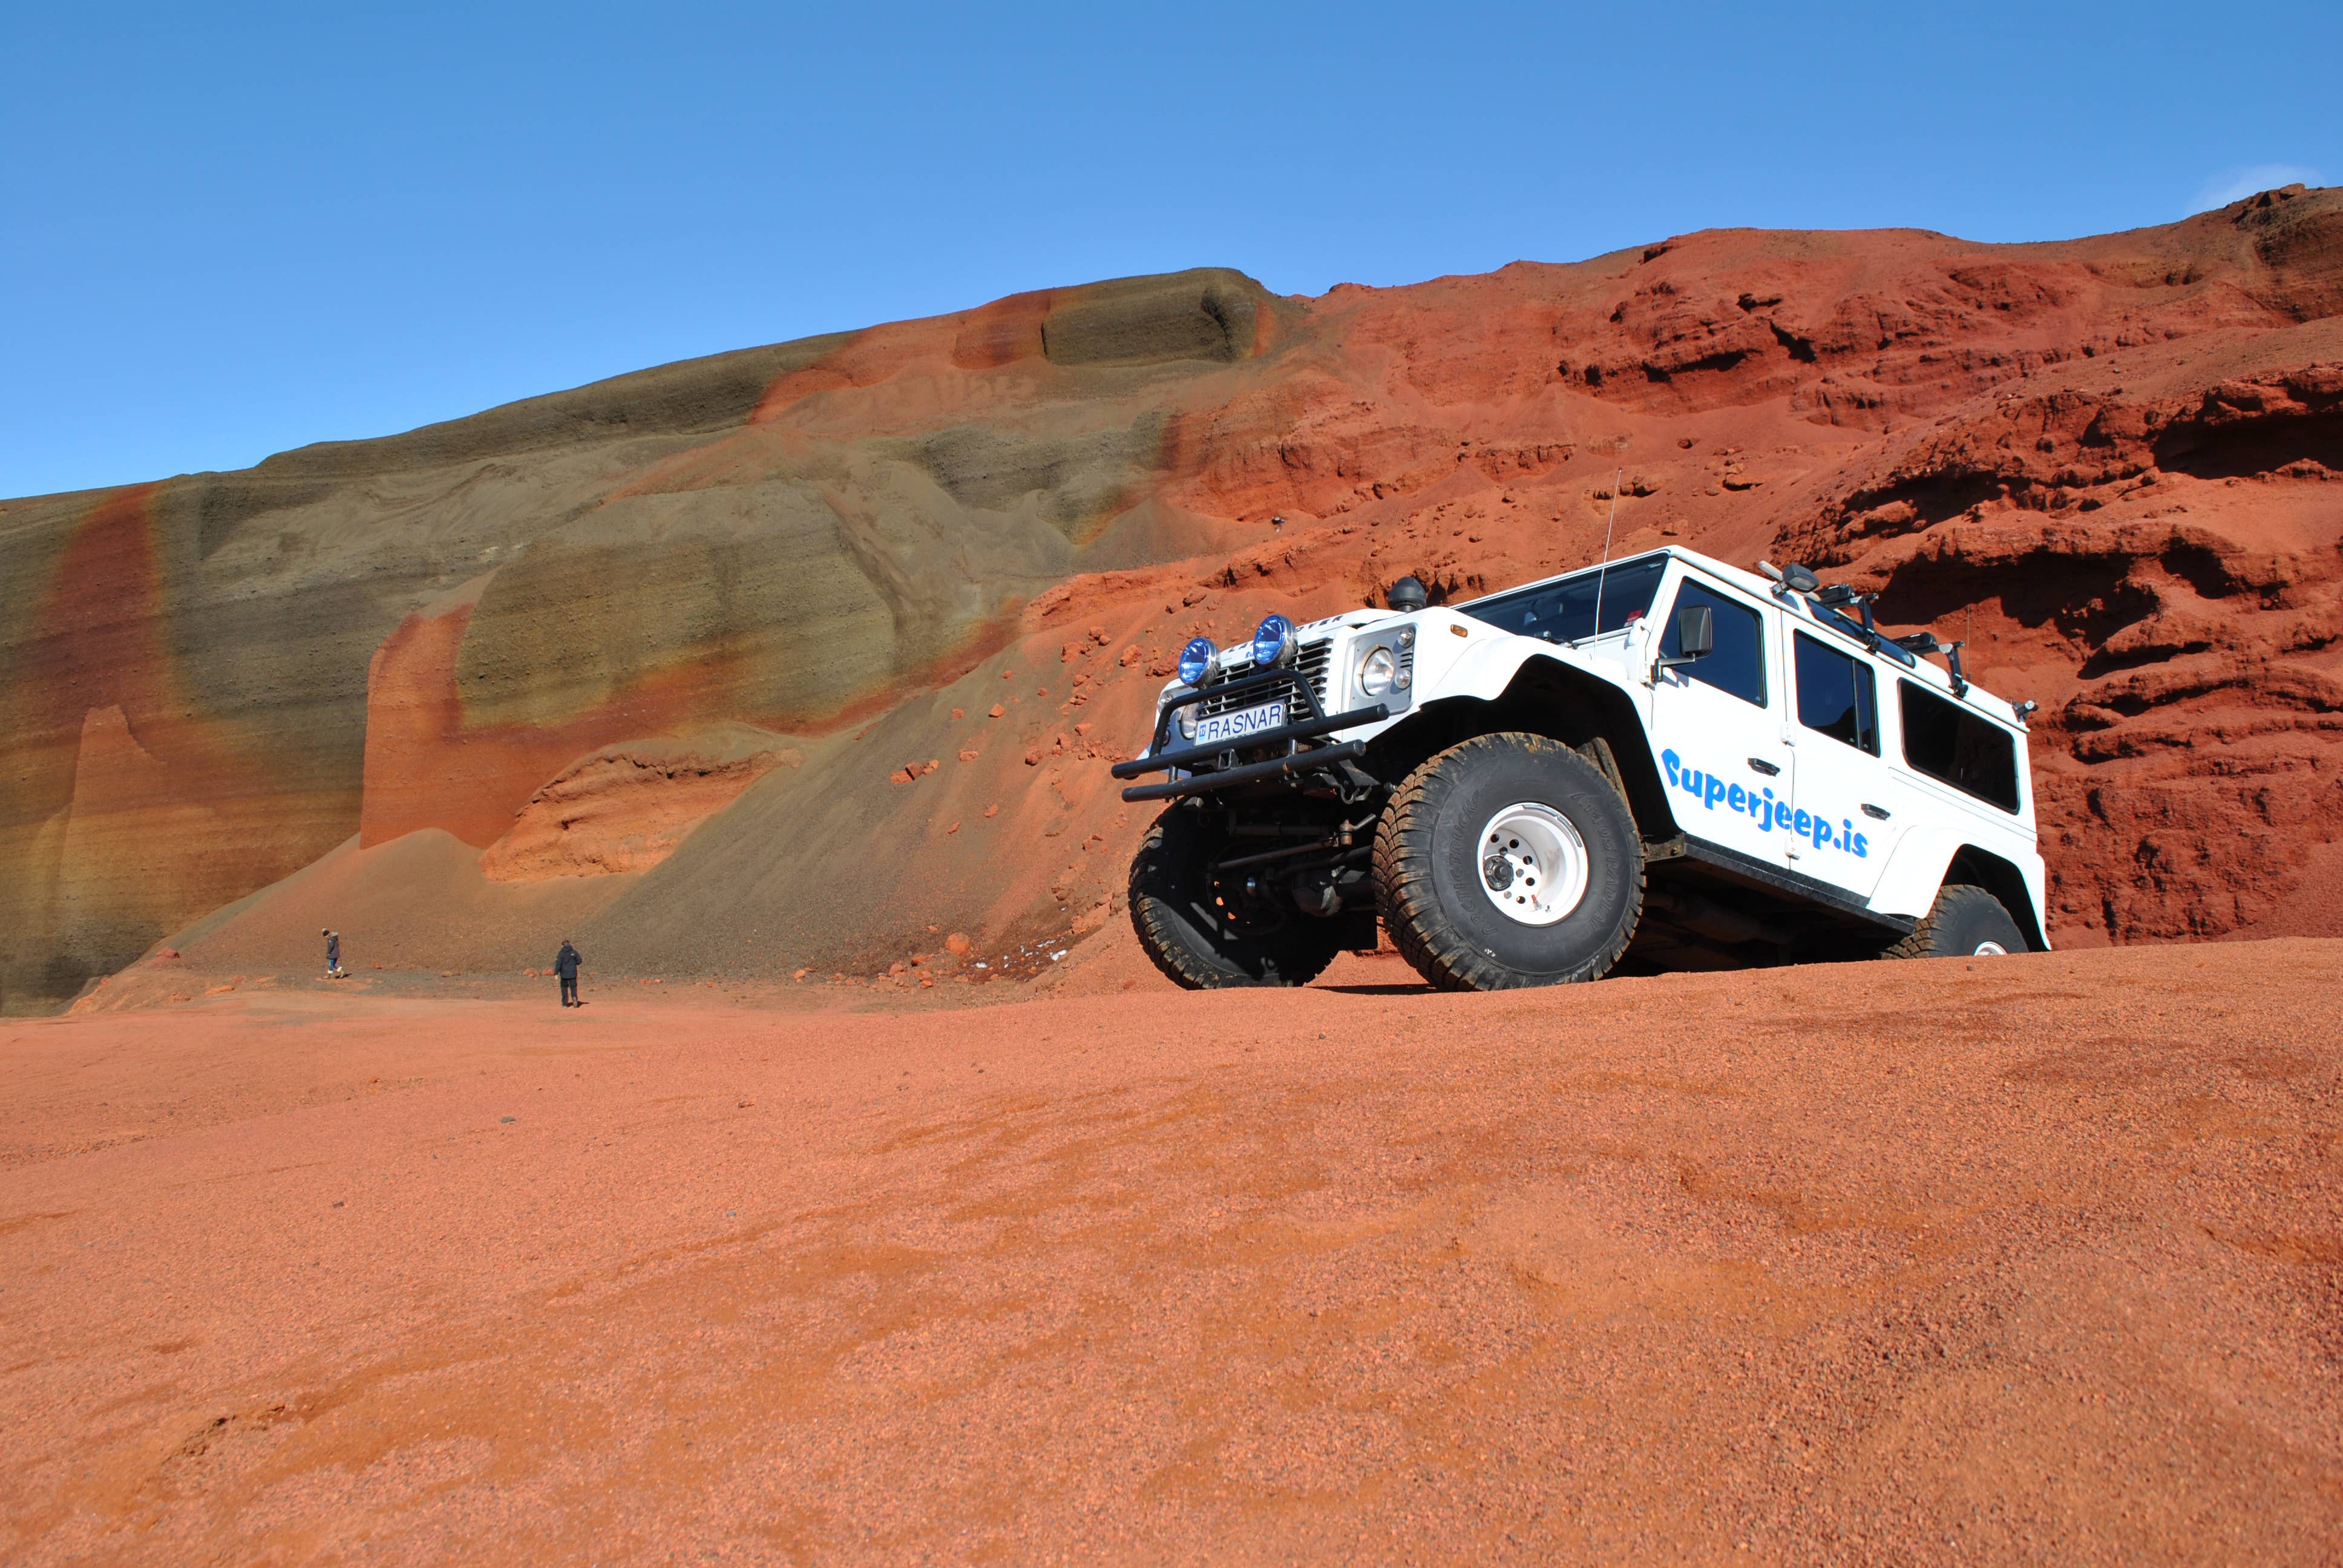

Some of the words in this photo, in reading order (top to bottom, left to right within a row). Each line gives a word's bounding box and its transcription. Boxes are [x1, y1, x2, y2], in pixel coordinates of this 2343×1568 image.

[1296, 615, 1343, 632] OVER
[1208, 705, 1280, 740] RASNAR
[1449, 789, 1482, 866] TRUCKS
[1661, 748, 1868, 858] Superjeep.is
